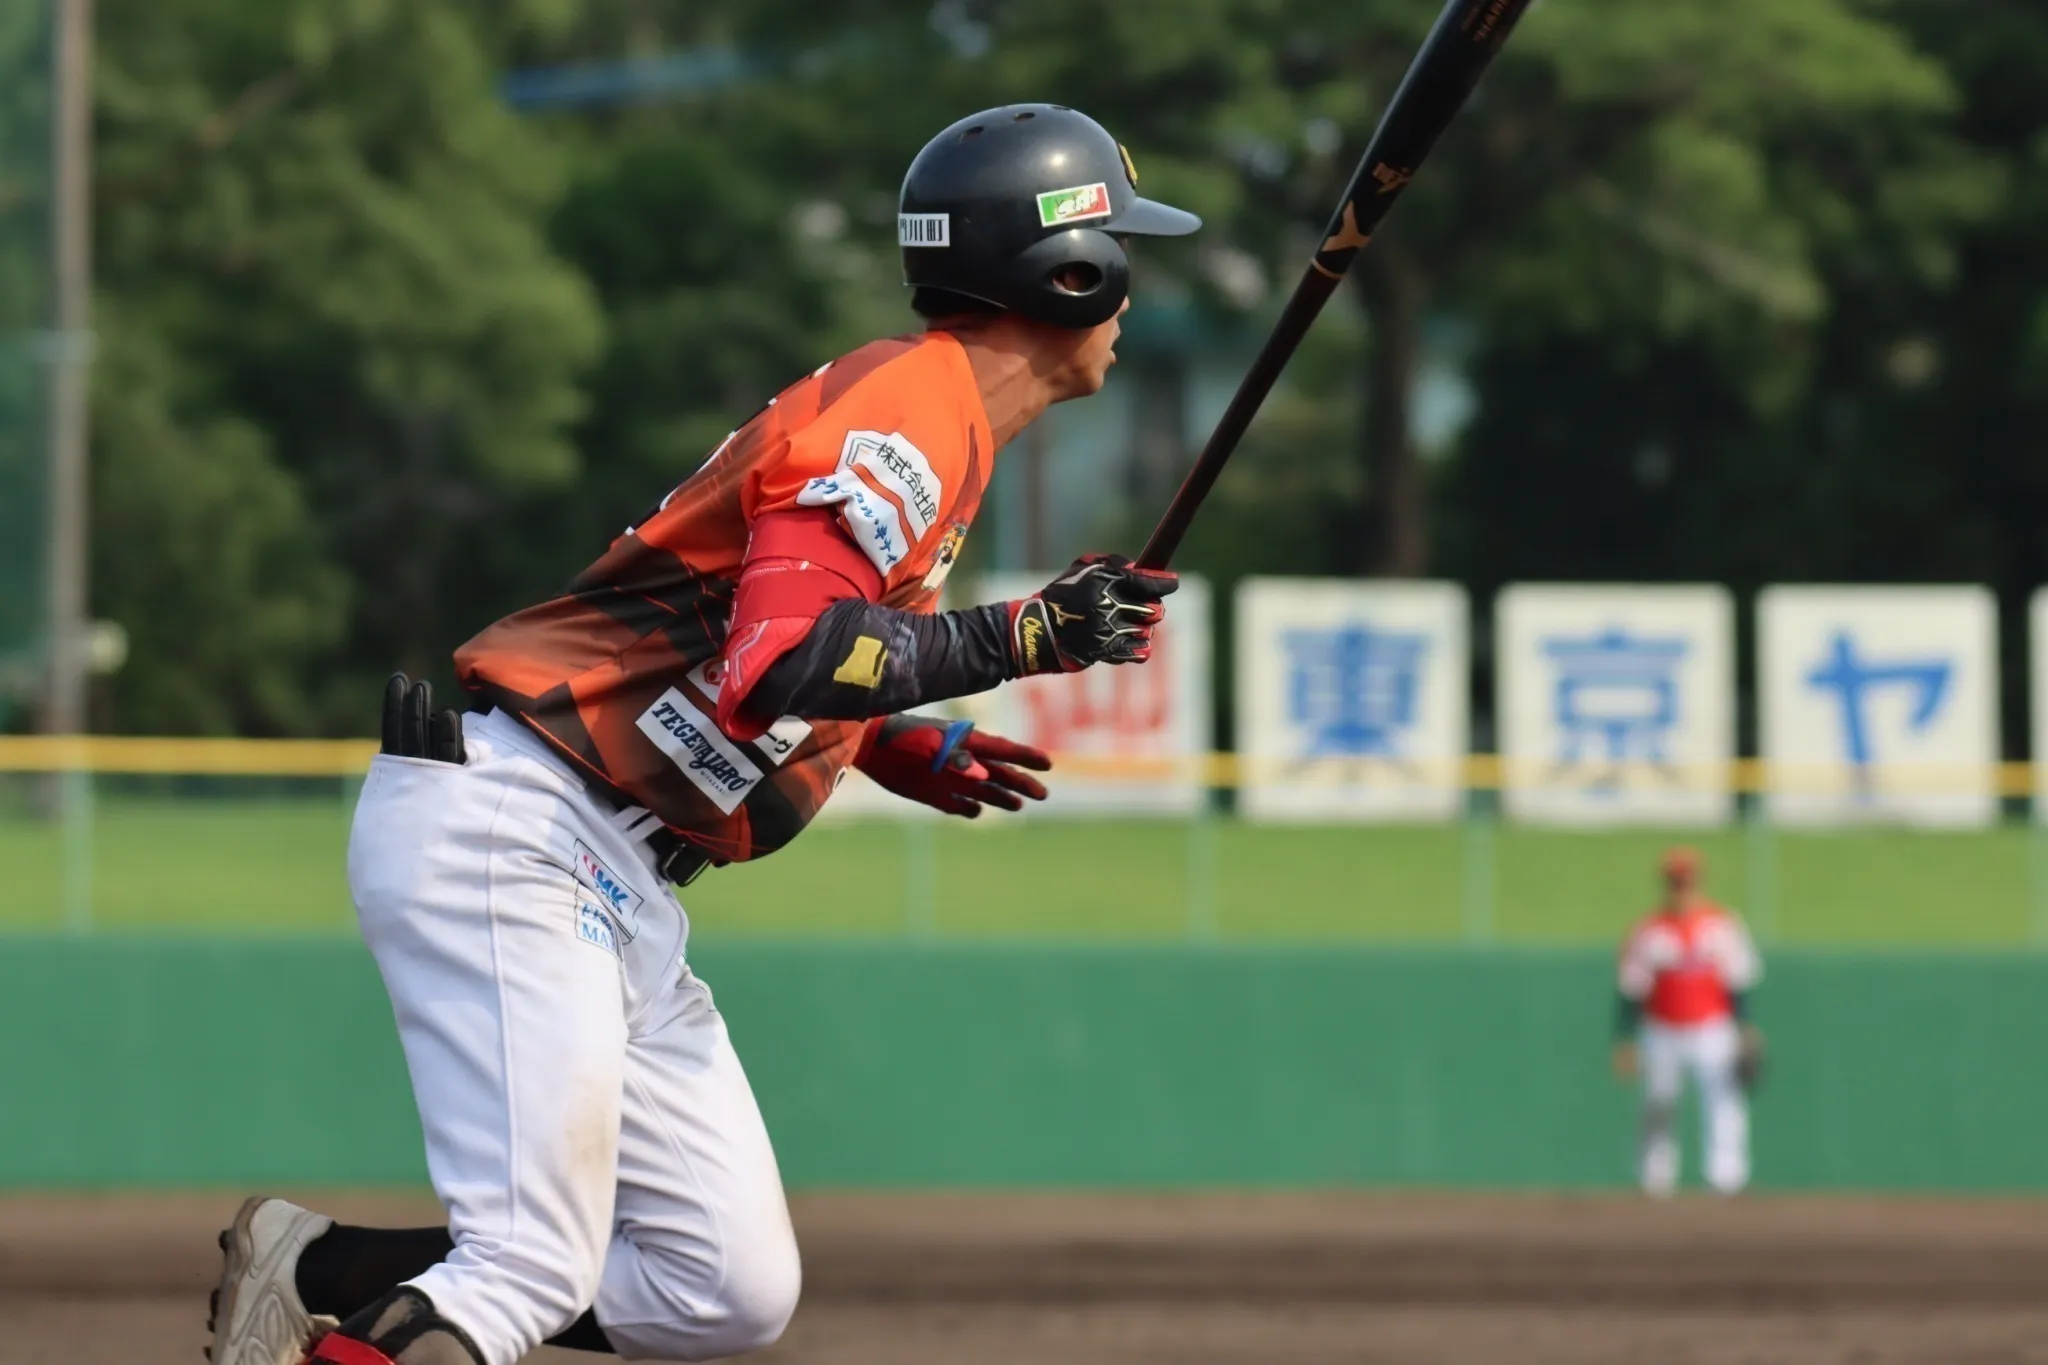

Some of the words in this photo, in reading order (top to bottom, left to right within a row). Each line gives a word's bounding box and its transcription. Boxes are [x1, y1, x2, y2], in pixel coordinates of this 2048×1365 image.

[876, 441, 938, 527] 株式会社匠
[651, 701, 748, 792] TEGEVAJARO
